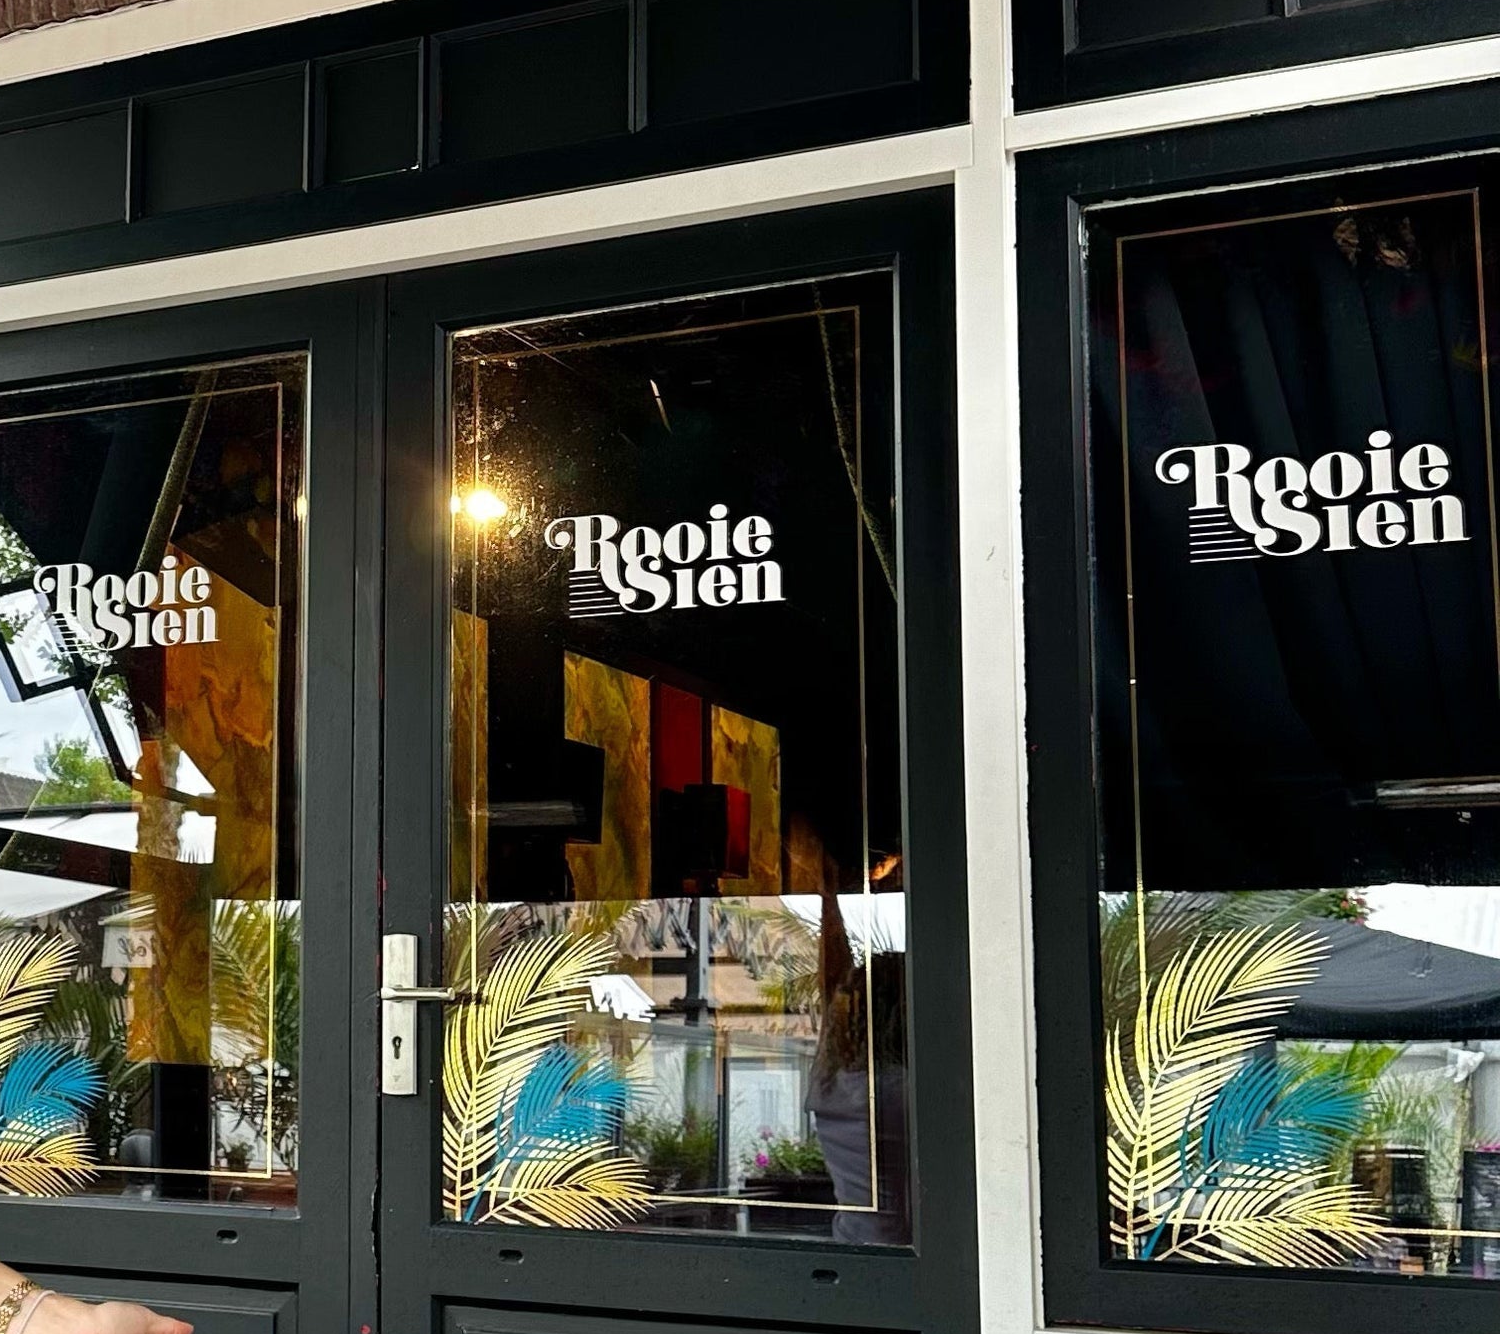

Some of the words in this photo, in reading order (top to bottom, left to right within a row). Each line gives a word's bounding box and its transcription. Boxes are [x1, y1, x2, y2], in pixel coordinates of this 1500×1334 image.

[1155, 430, 1450, 517] Rooie
[544, 504, 774, 579] Rooie
[1255, 490, 1472, 557] Sien
[33, 555, 211, 623] Rooie
[619, 555, 787, 613] Sien
[92, 600, 220, 651] Sien
